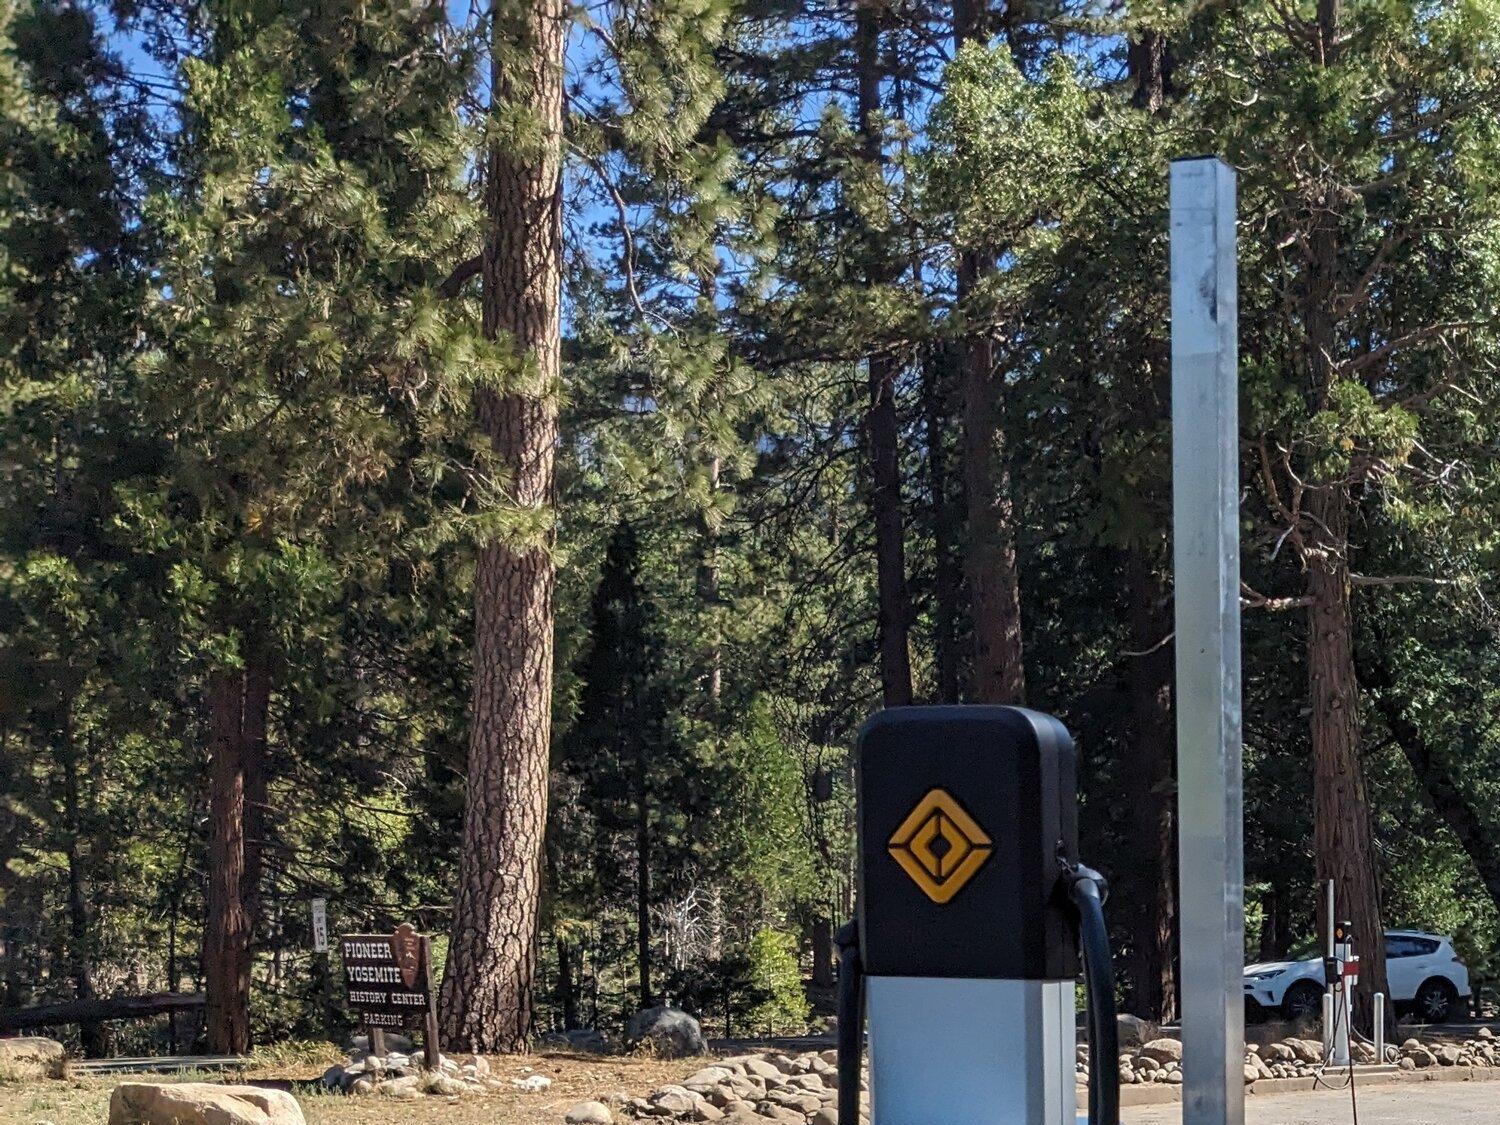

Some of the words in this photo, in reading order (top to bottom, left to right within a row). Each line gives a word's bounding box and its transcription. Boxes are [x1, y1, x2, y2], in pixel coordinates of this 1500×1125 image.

[343, 942, 393, 959] PIONEER
[347, 966, 402, 983] YOSEMITE
[349, 991, 387, 1004] HISTORY
[391, 993, 426, 1005] CENTER
[364, 1013, 403, 1026] PARKING
